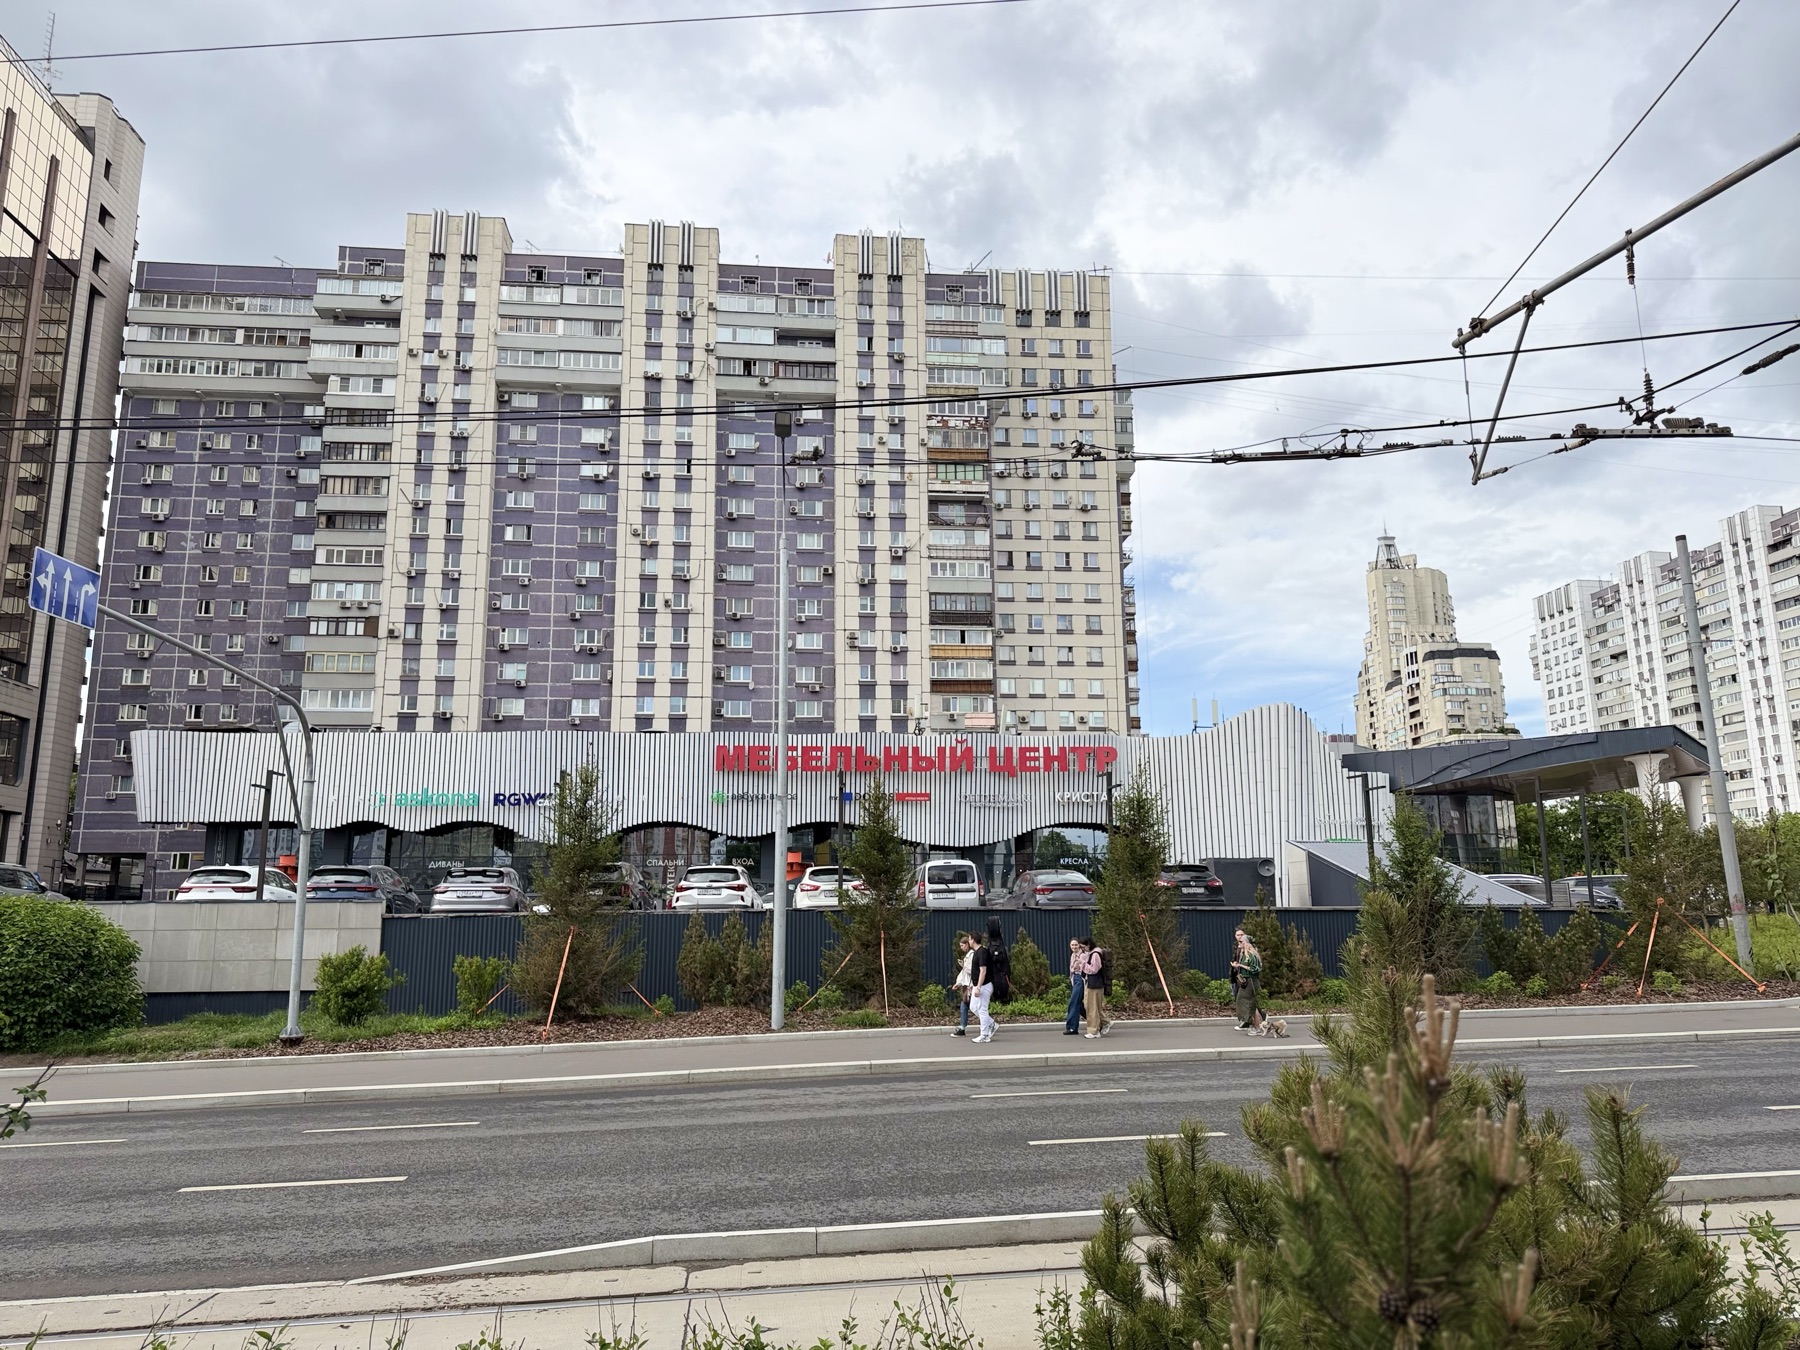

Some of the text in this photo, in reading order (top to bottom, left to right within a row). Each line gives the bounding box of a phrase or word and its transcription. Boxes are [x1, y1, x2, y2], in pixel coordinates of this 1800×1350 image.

[716, 739, 1118, 777] МЕБЕЛЬНЫЙ ЦЕНТР
[395, 788, 479, 806] askona
[428, 860, 465, 868] ДИВАНЫ
[732, 857, 755, 866] ВХОД
